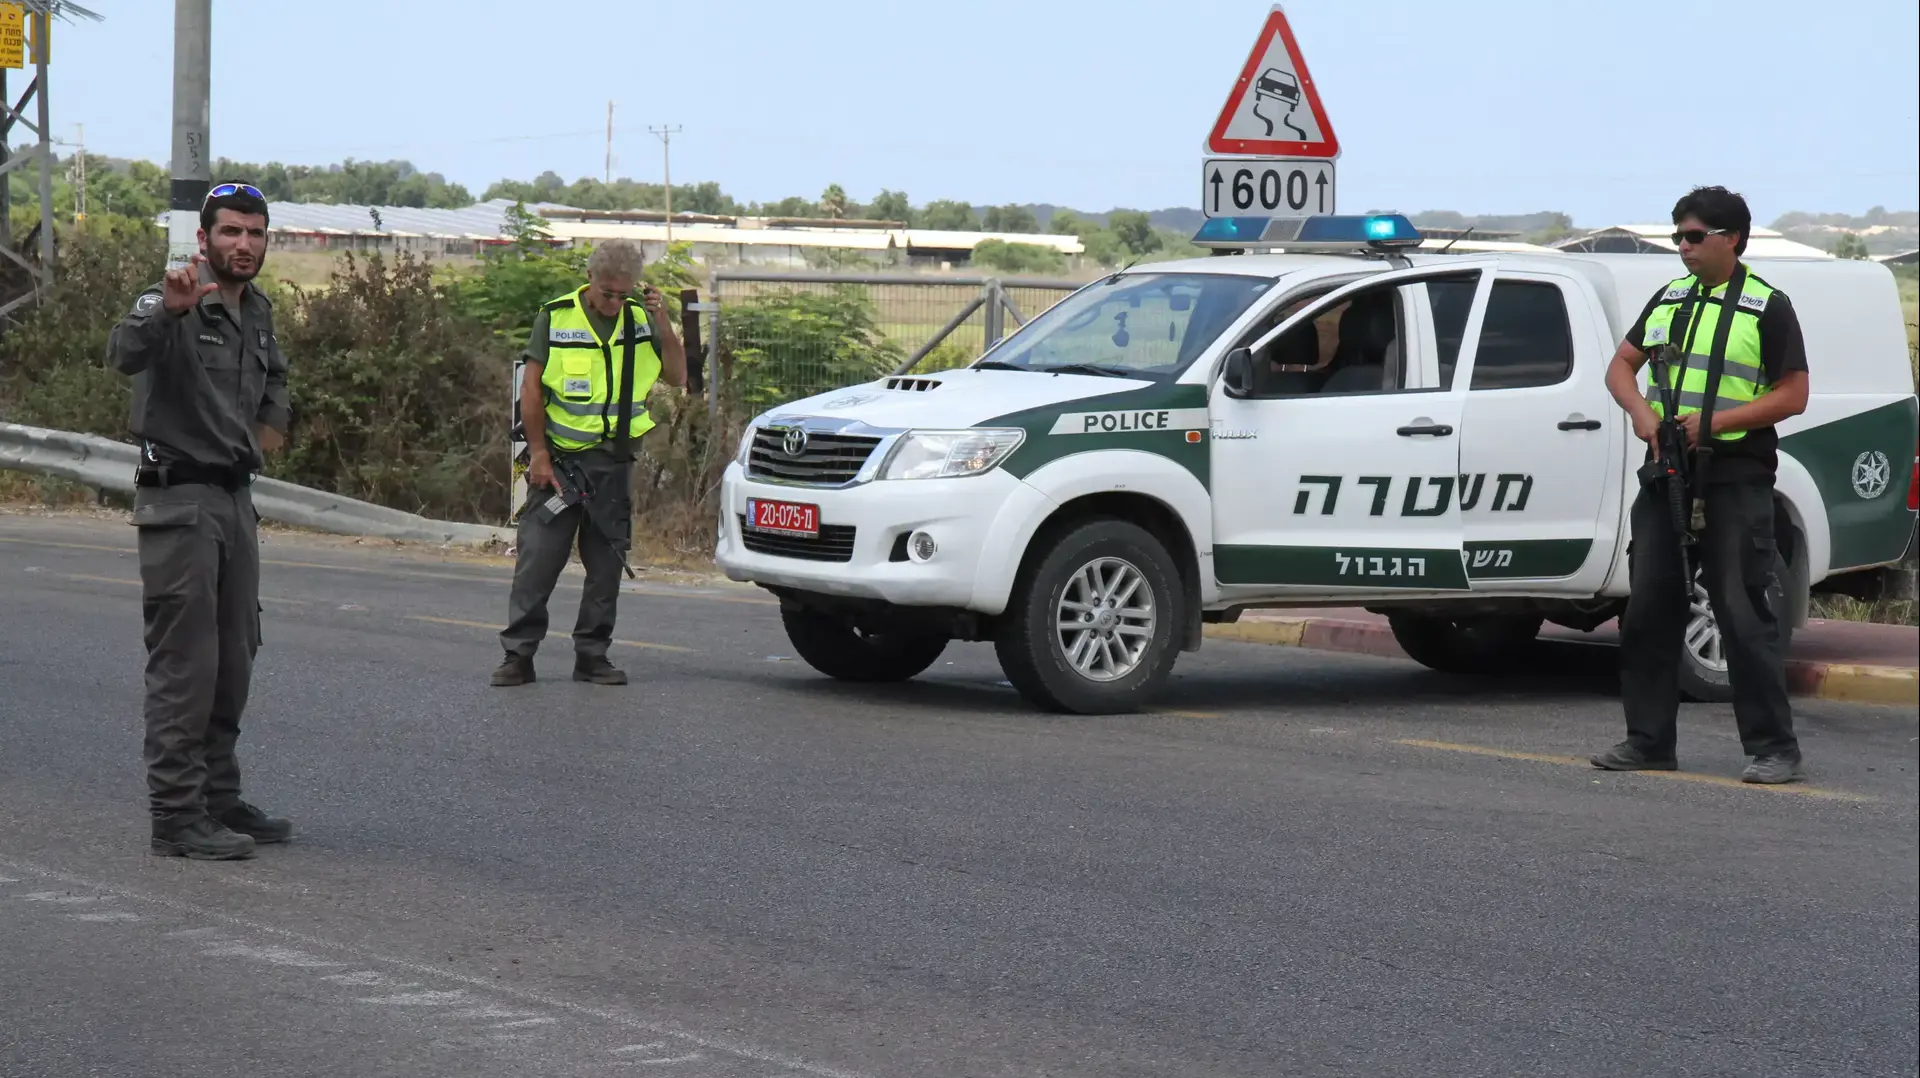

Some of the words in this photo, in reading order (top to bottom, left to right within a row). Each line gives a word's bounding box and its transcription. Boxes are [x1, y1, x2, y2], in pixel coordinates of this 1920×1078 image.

[1232, 169, 1308, 210] 600
[1666, 288, 1690, 298] POLIC
[1741, 295, 1763, 307] משט
[555, 331, 587, 340] POLICE
[1084, 411, 1169, 432] POLICE
[1335, 553, 1426, 576] הגבול
[1463, 550, 1513, 568] מש
